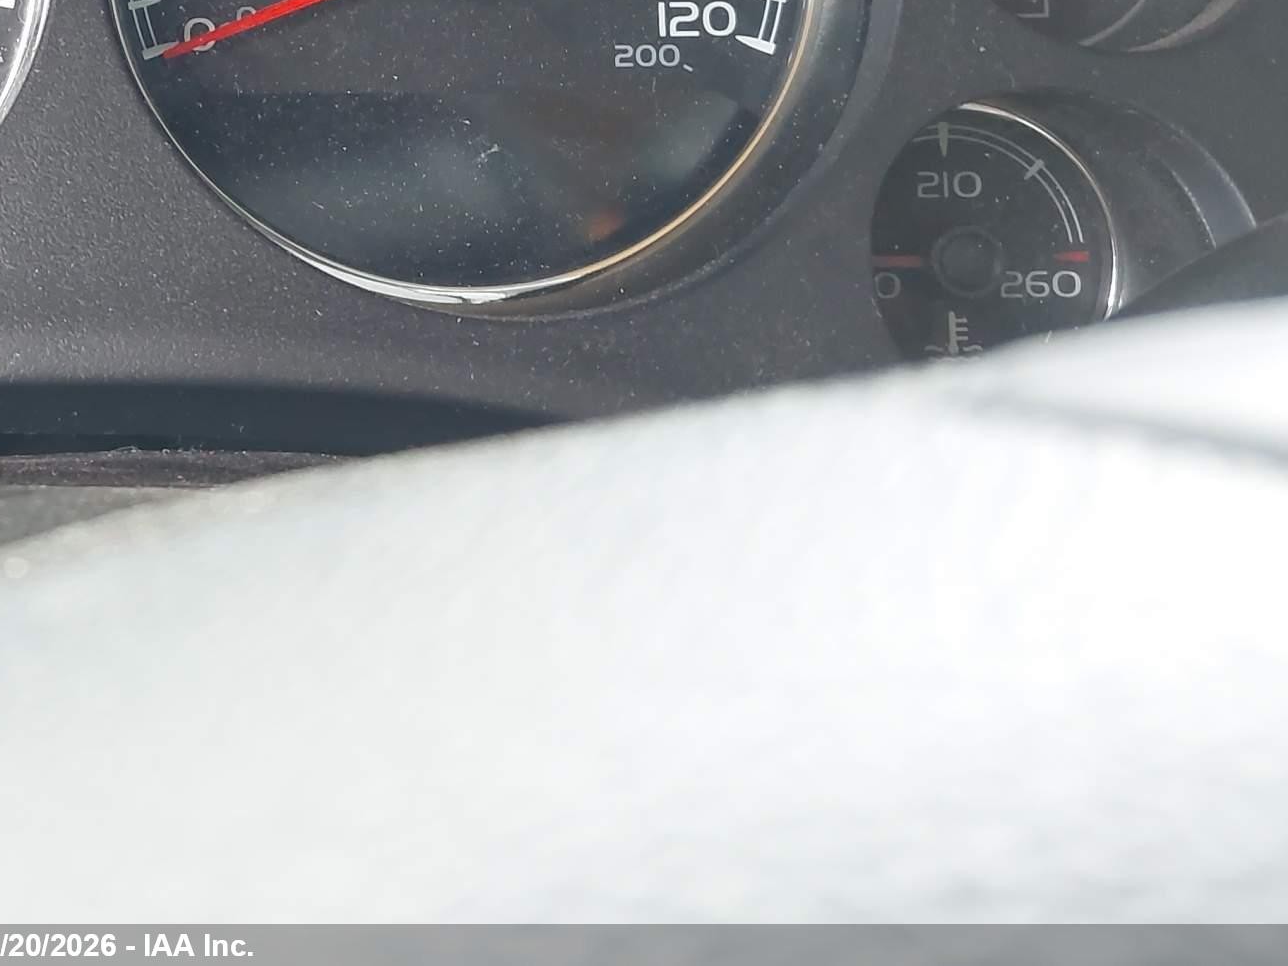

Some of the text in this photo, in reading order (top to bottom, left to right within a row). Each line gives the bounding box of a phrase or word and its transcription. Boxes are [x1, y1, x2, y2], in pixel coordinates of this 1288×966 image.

[658, 1, 737, 37] 120
[614, 44, 680, 68] 200
[917, 171, 982, 198] 210
[1000, 270, 1082, 298] 260
